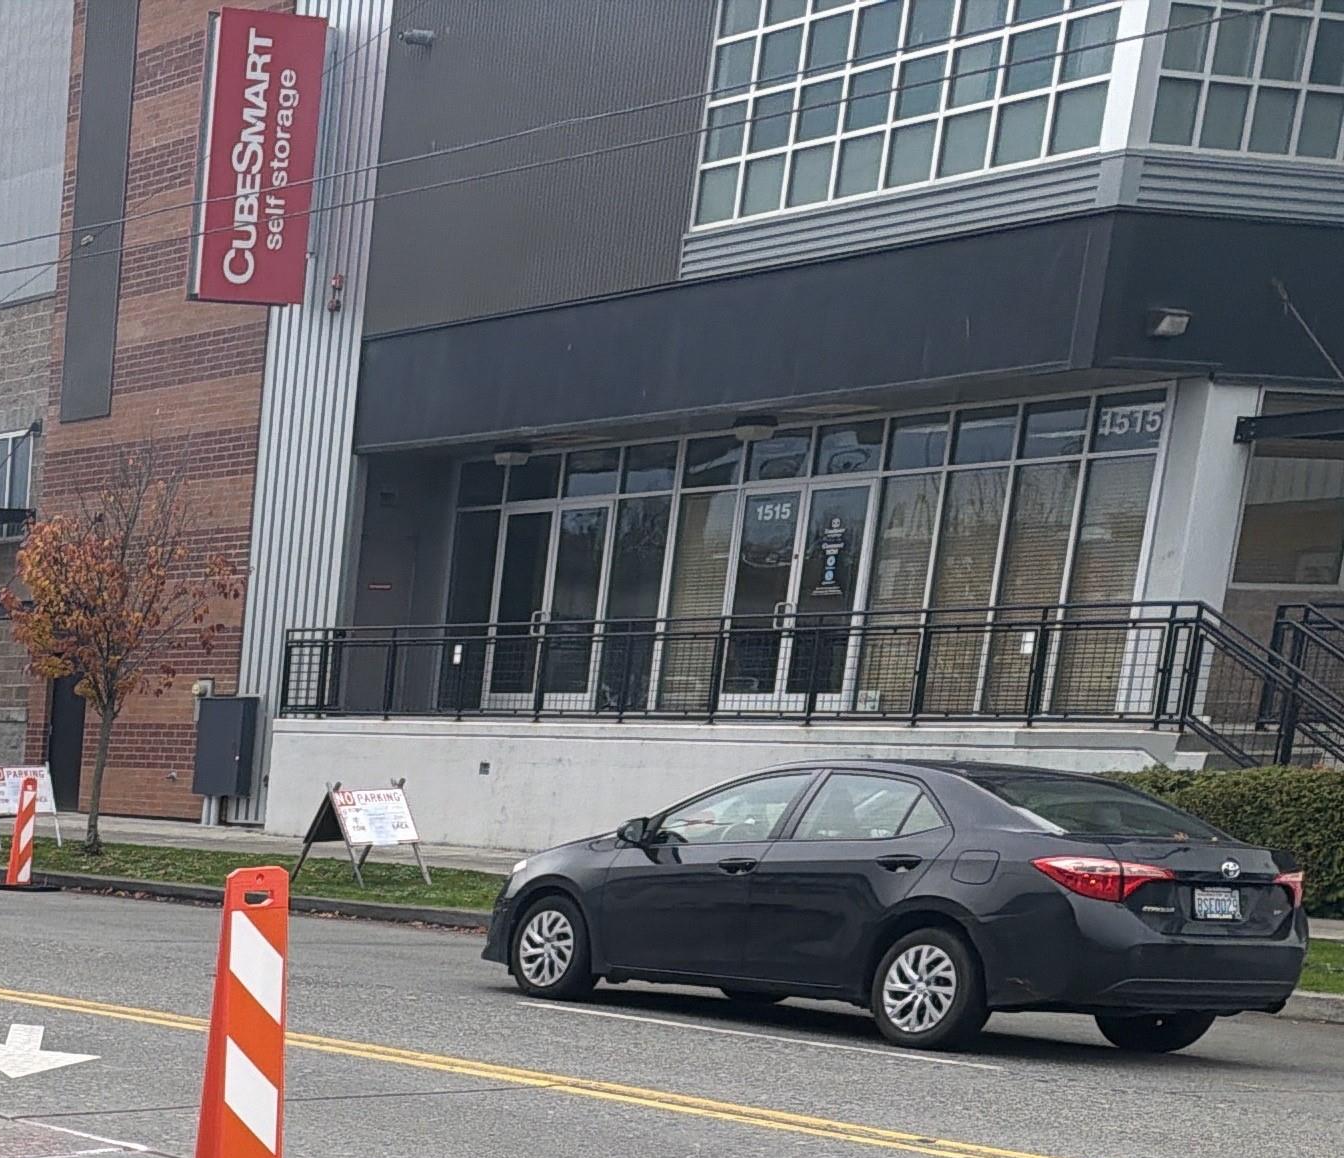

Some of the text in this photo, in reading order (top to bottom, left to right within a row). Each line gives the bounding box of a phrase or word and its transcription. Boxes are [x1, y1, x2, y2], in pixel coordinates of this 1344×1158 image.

[266, 68, 297, 252] self storage
[757, 503, 791, 520] 1515
[335, 791, 401, 805] NO PARKING
